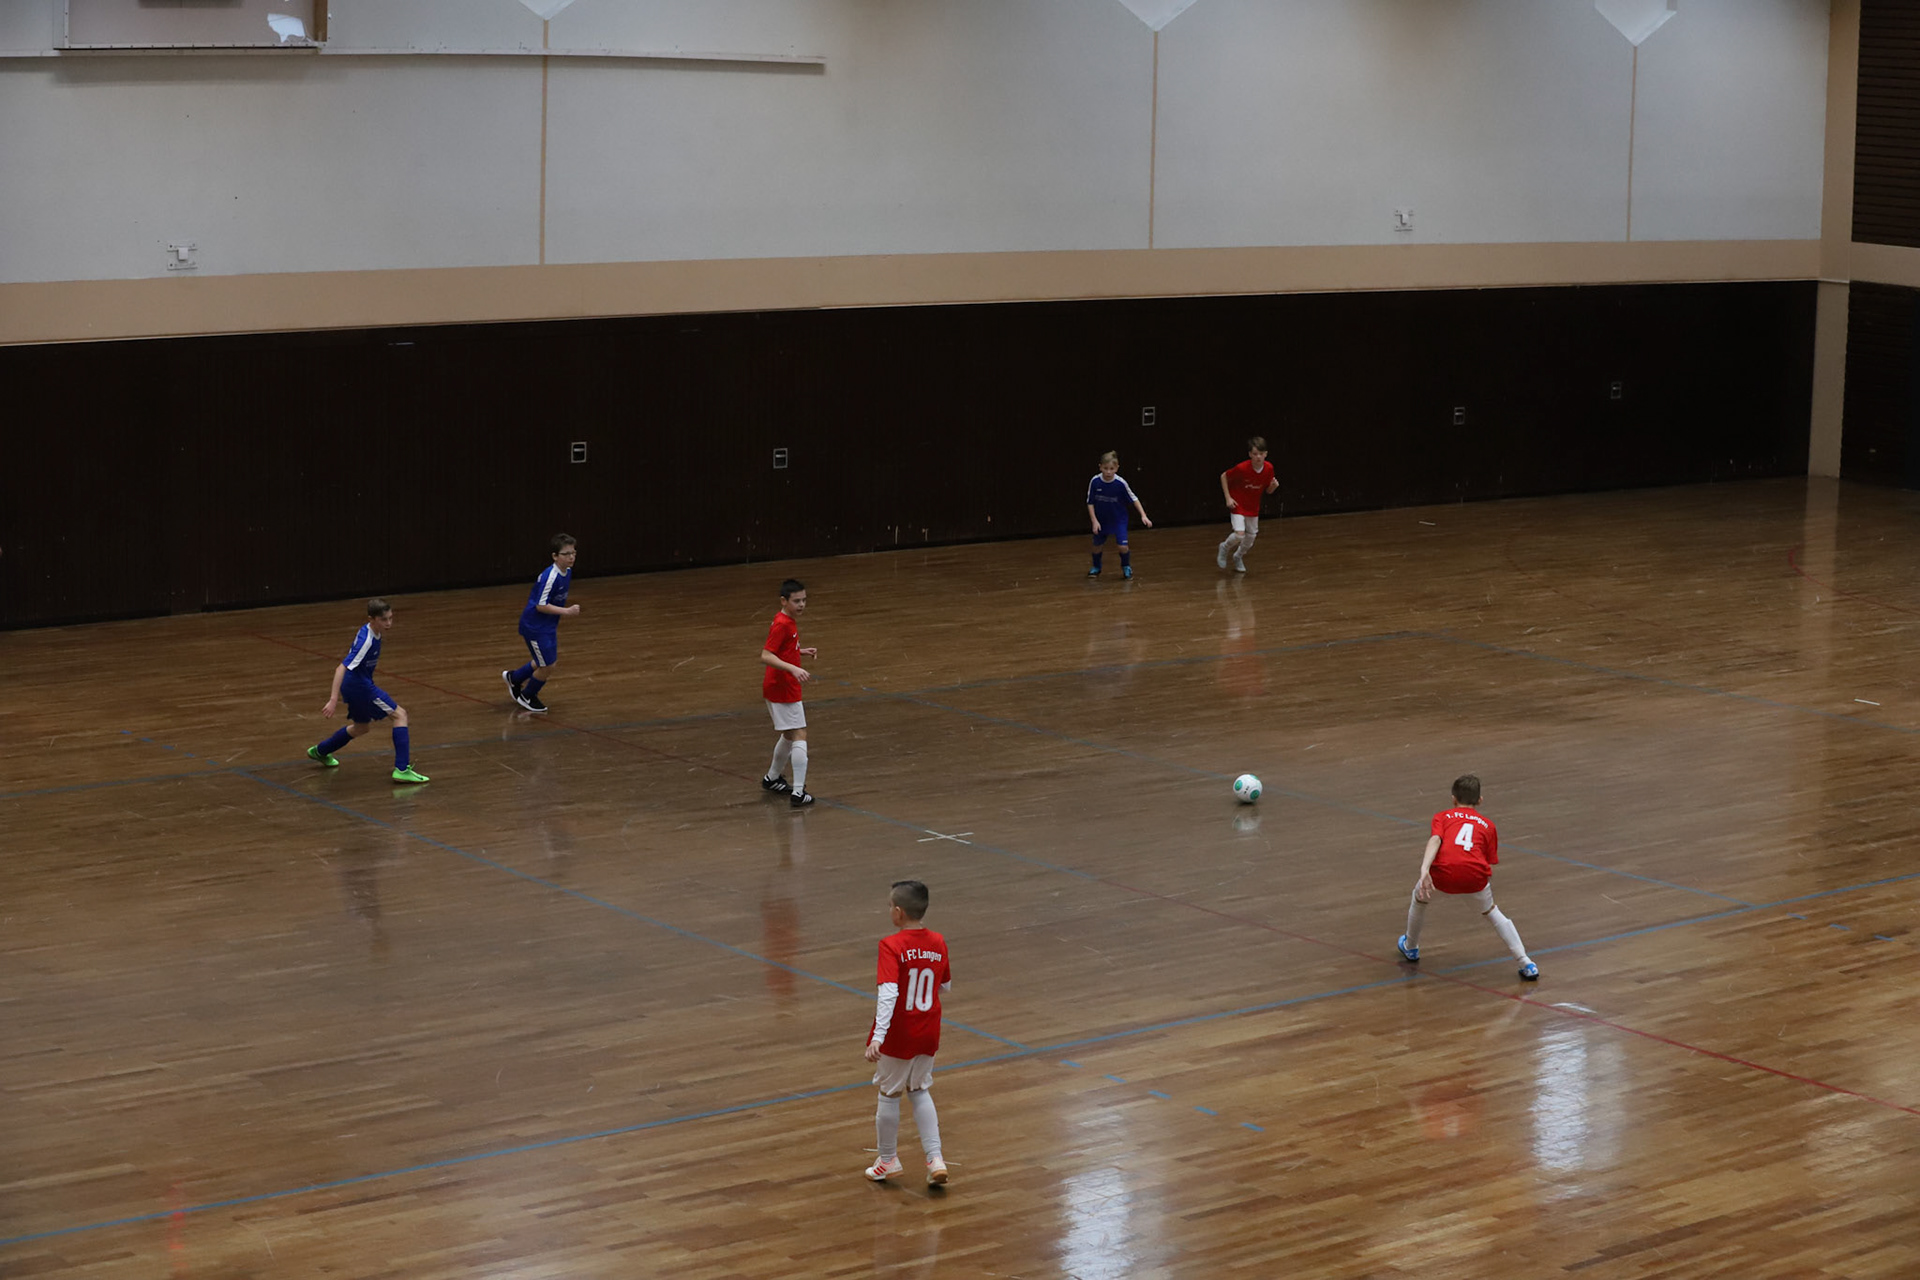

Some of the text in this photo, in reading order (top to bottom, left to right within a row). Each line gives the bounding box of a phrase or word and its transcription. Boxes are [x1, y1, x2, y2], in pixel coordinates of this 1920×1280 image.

[1465, 813, 1489, 829] Langen
[1455, 822, 1474, 852] 4
[907, 949, 917, 961] FC
[918, 948, 942, 962] Langen
[906, 967, 935, 1012] 10
